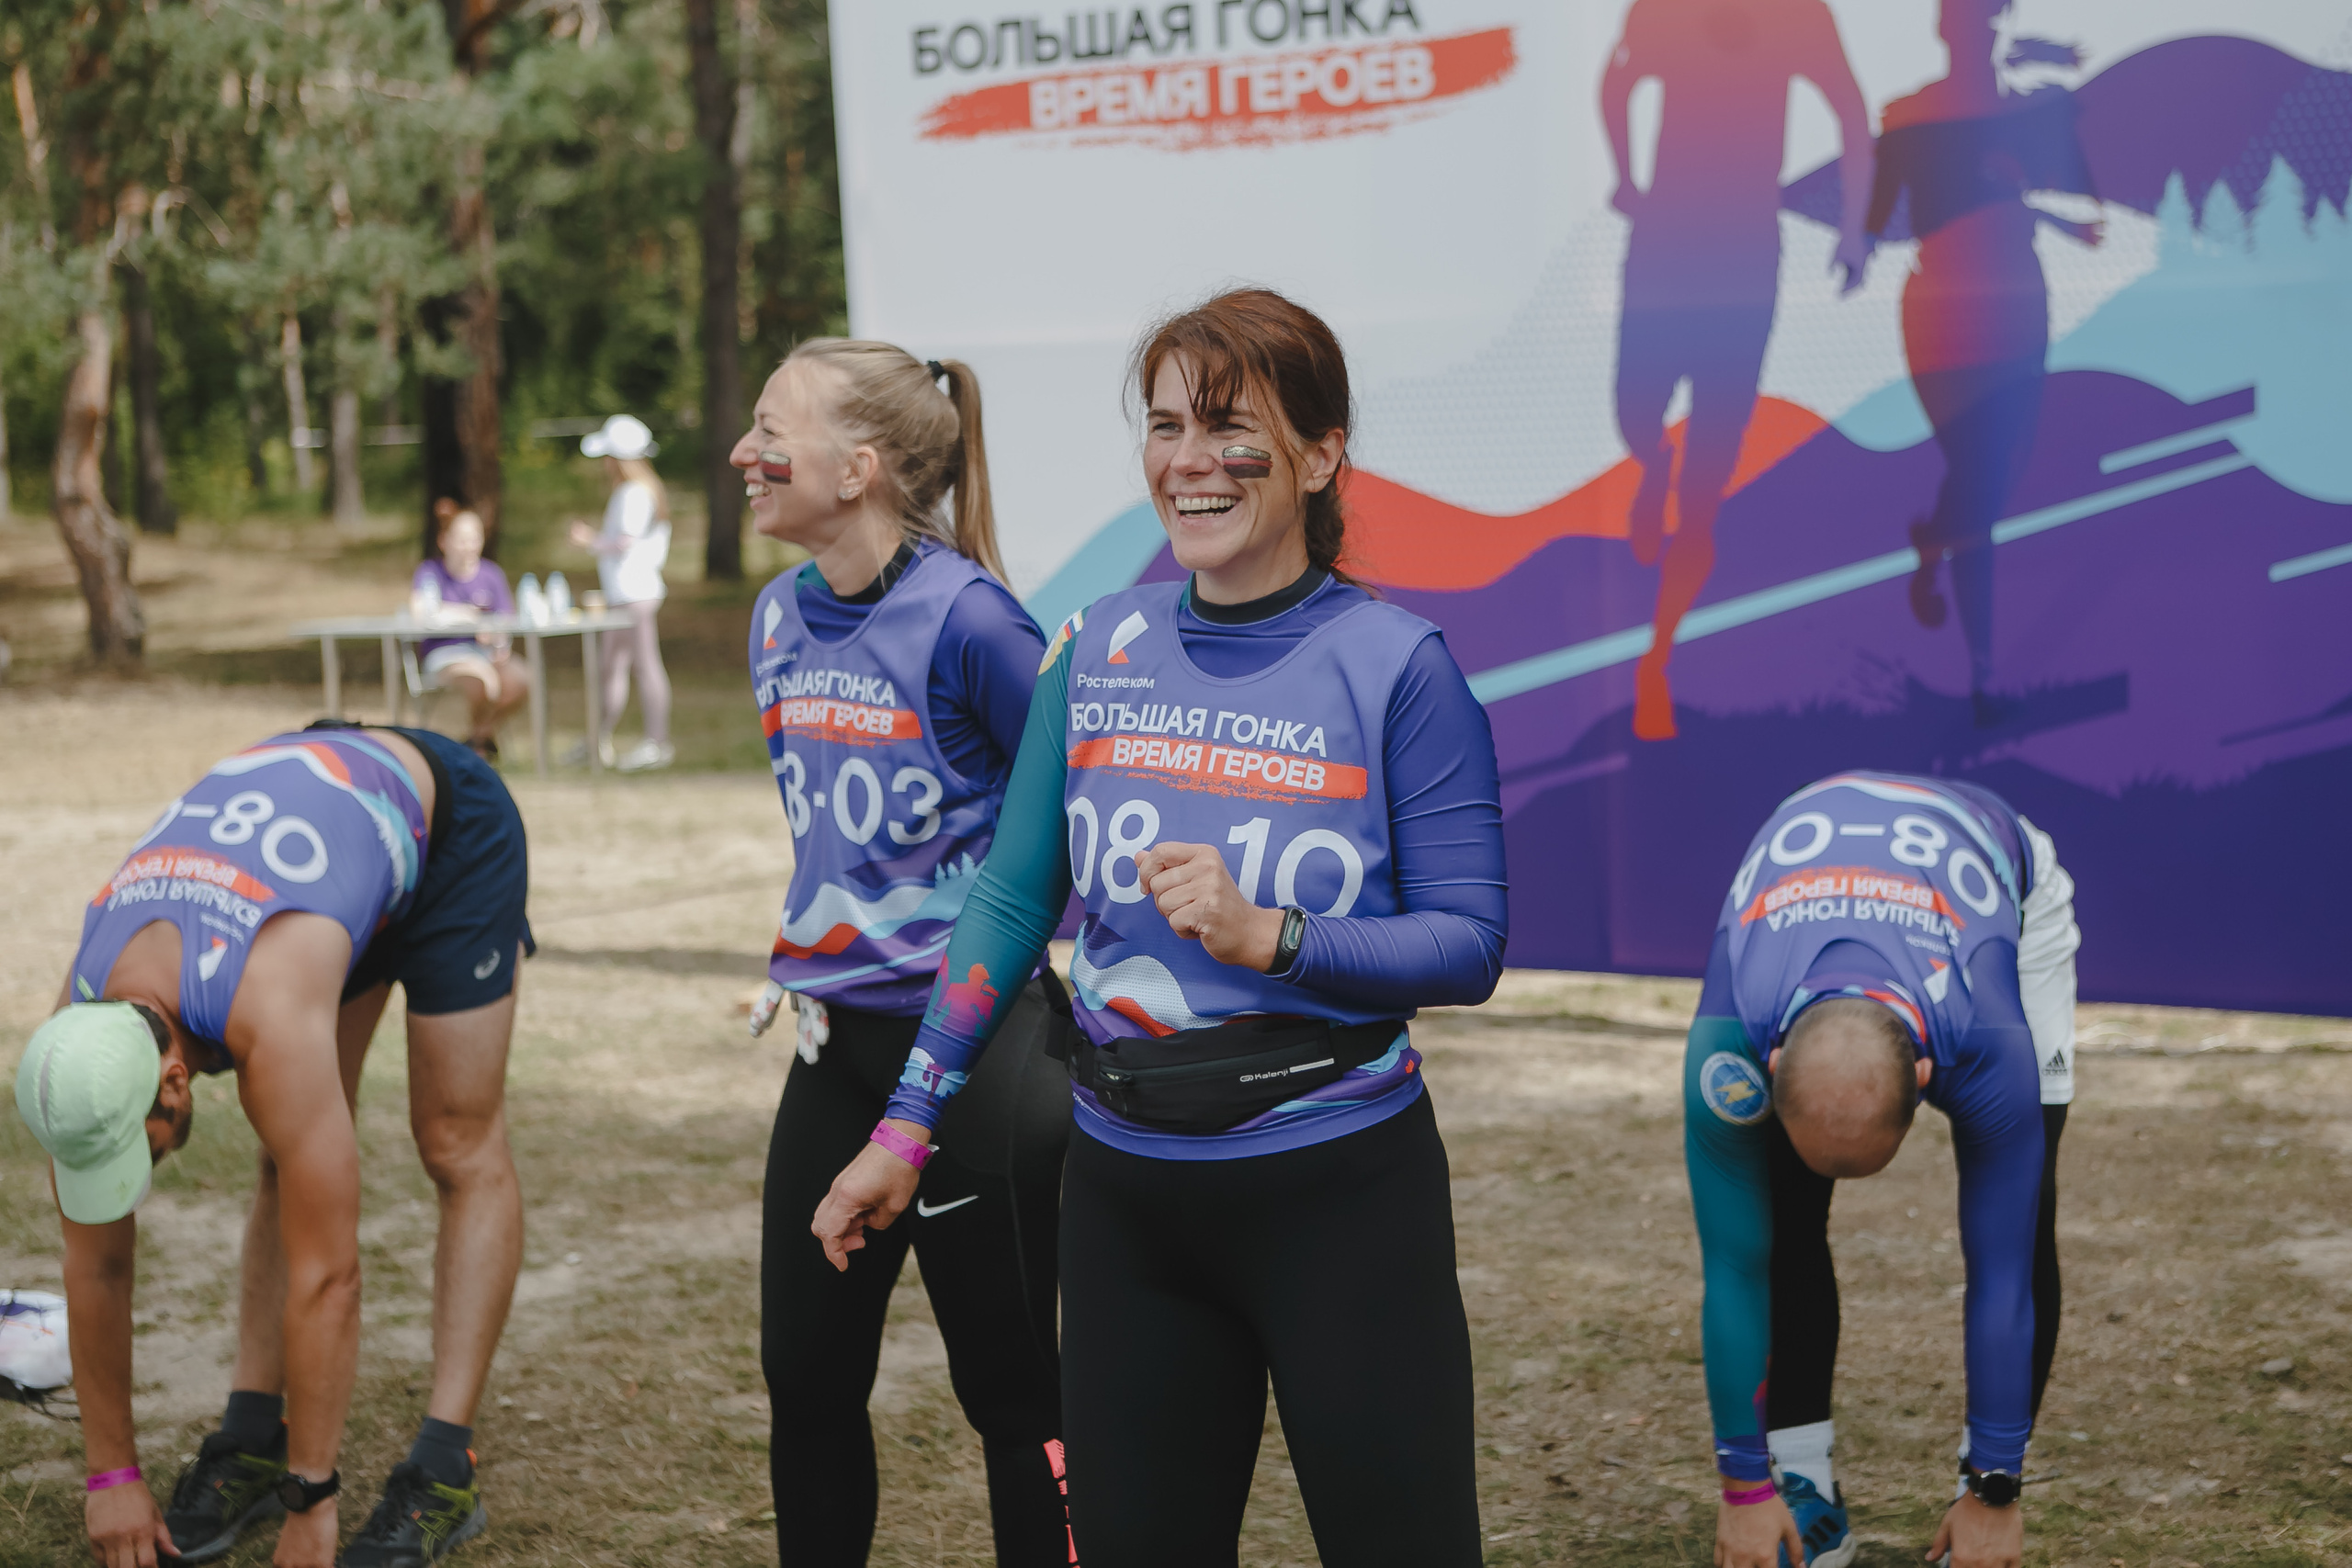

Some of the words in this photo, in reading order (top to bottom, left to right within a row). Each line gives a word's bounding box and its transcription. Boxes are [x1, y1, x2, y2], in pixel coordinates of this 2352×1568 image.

[912, 6, 1193, 75] БОЛЬШАЯ
[1027, 65, 1208, 130] ВРЕМЯ
[1222, 48, 1435, 115] ГЕРОЕВ
[826, 669, 896, 707] ГОНКА
[1077, 673, 1155, 690] Ростелеком
[825, 700, 895, 736] ГЕРОЕВ
[1070, 703, 1208, 738] БОЛЬШАЯ
[1212, 711, 1328, 758] ГОНКА
[1112, 738, 1203, 773] ВРЕМЯ
[1206, 747, 1327, 792] ГЕРОЕВ
[1763, 876, 1848, 912] ГЕРОЕВ
[1852, 875, 1935, 909] ВРЕМЯ
[1765, 898, 1849, 933] ГОНКА
[1254, 1068, 1289, 1080] Kalenji
